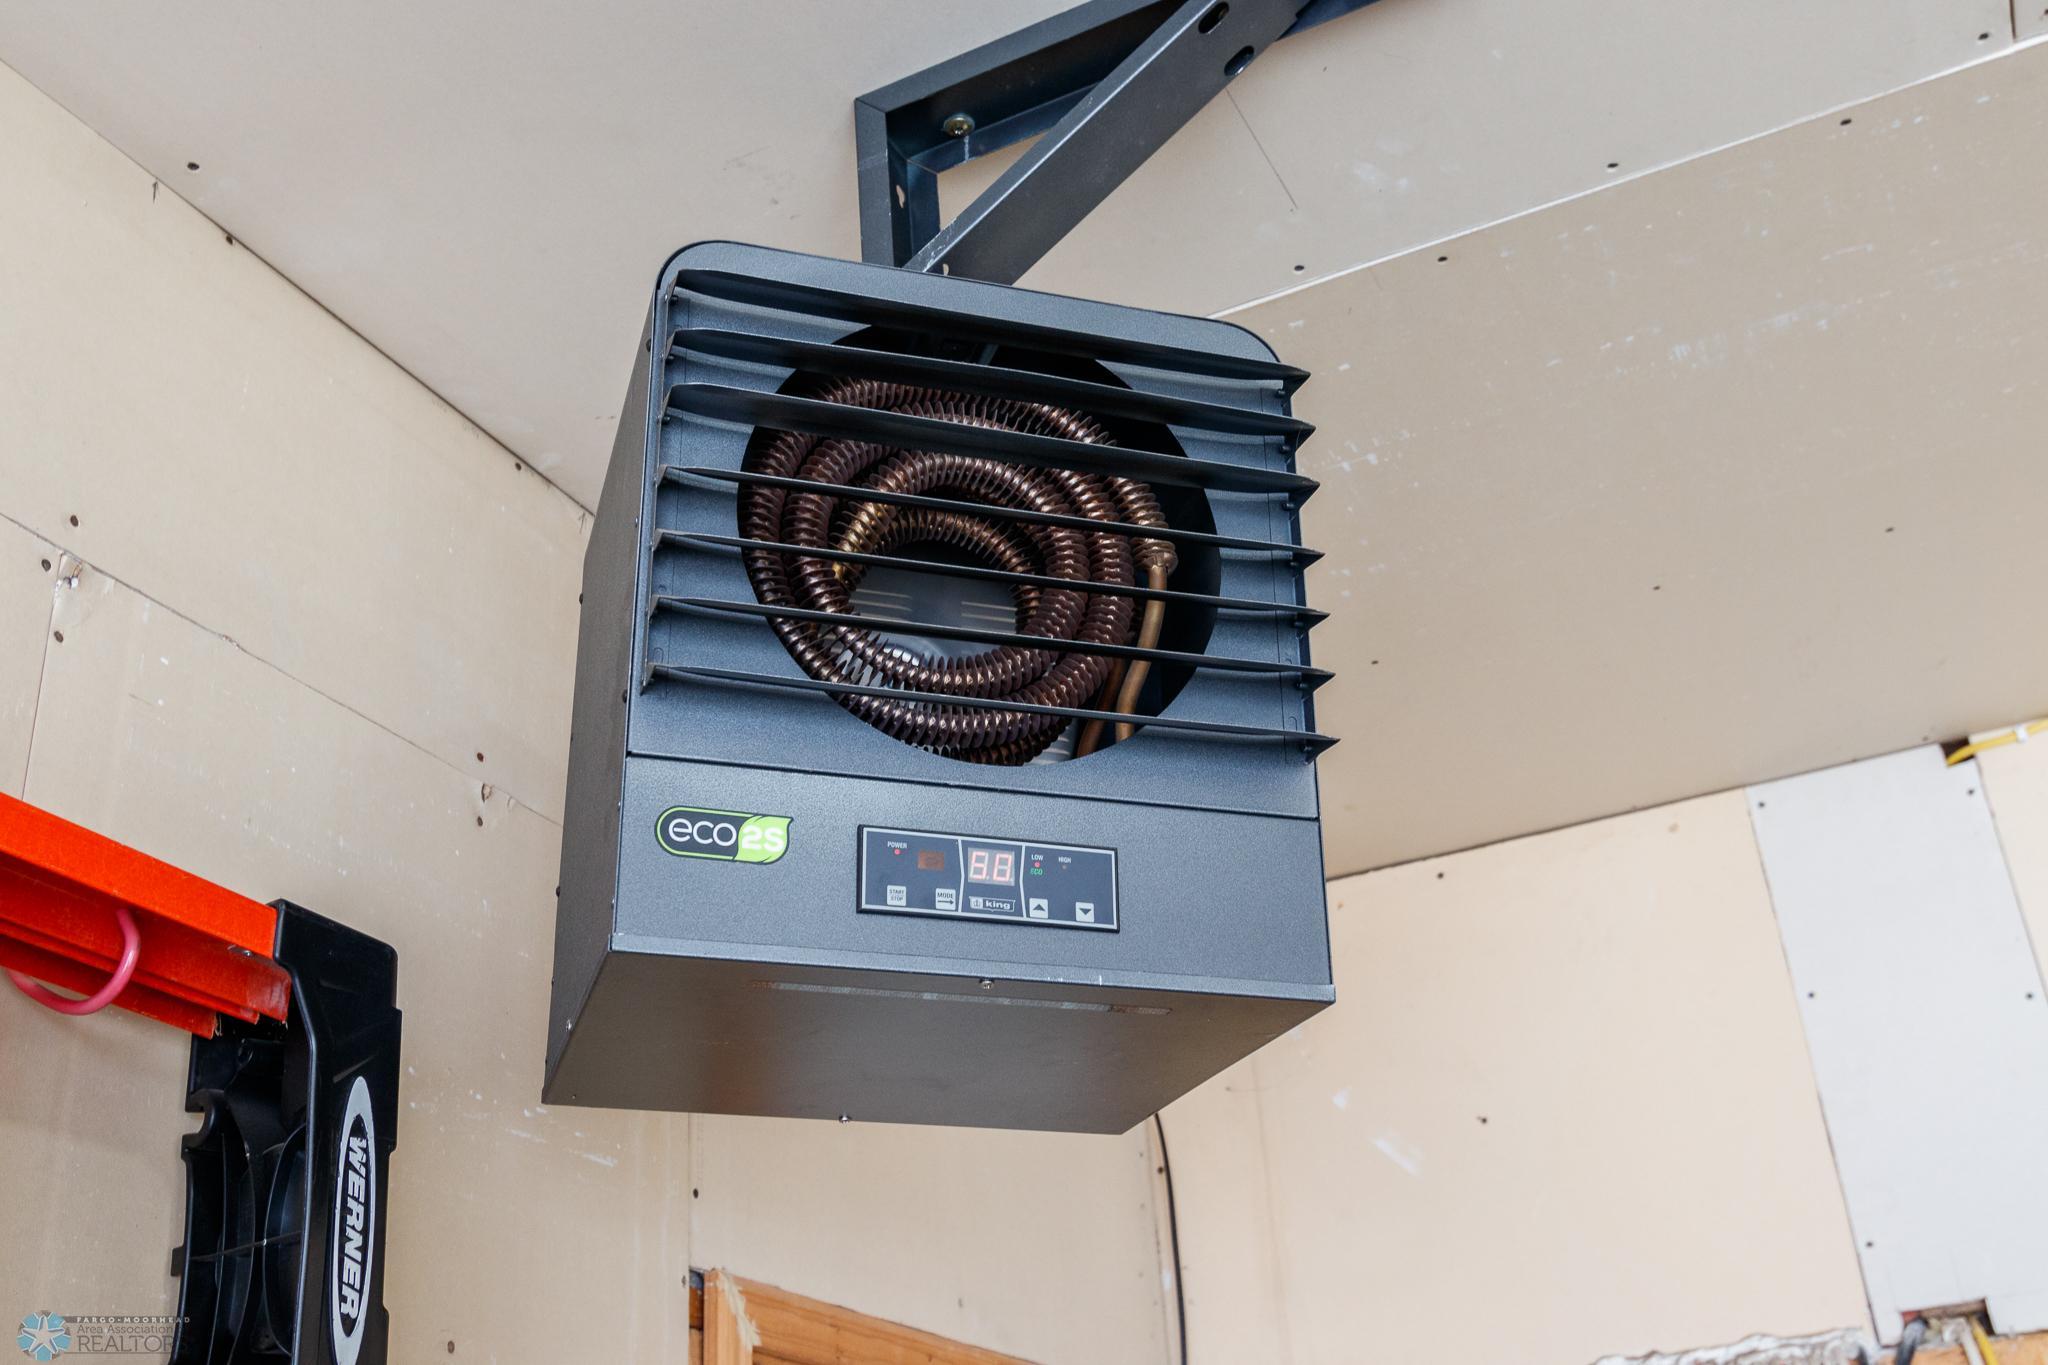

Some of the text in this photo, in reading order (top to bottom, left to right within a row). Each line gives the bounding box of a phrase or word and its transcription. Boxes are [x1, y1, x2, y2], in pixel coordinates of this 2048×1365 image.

[1030, 867, 1043, 875] ECO
[985, 900, 1011, 910] king
[340, 1136, 368, 1320] WERNER
